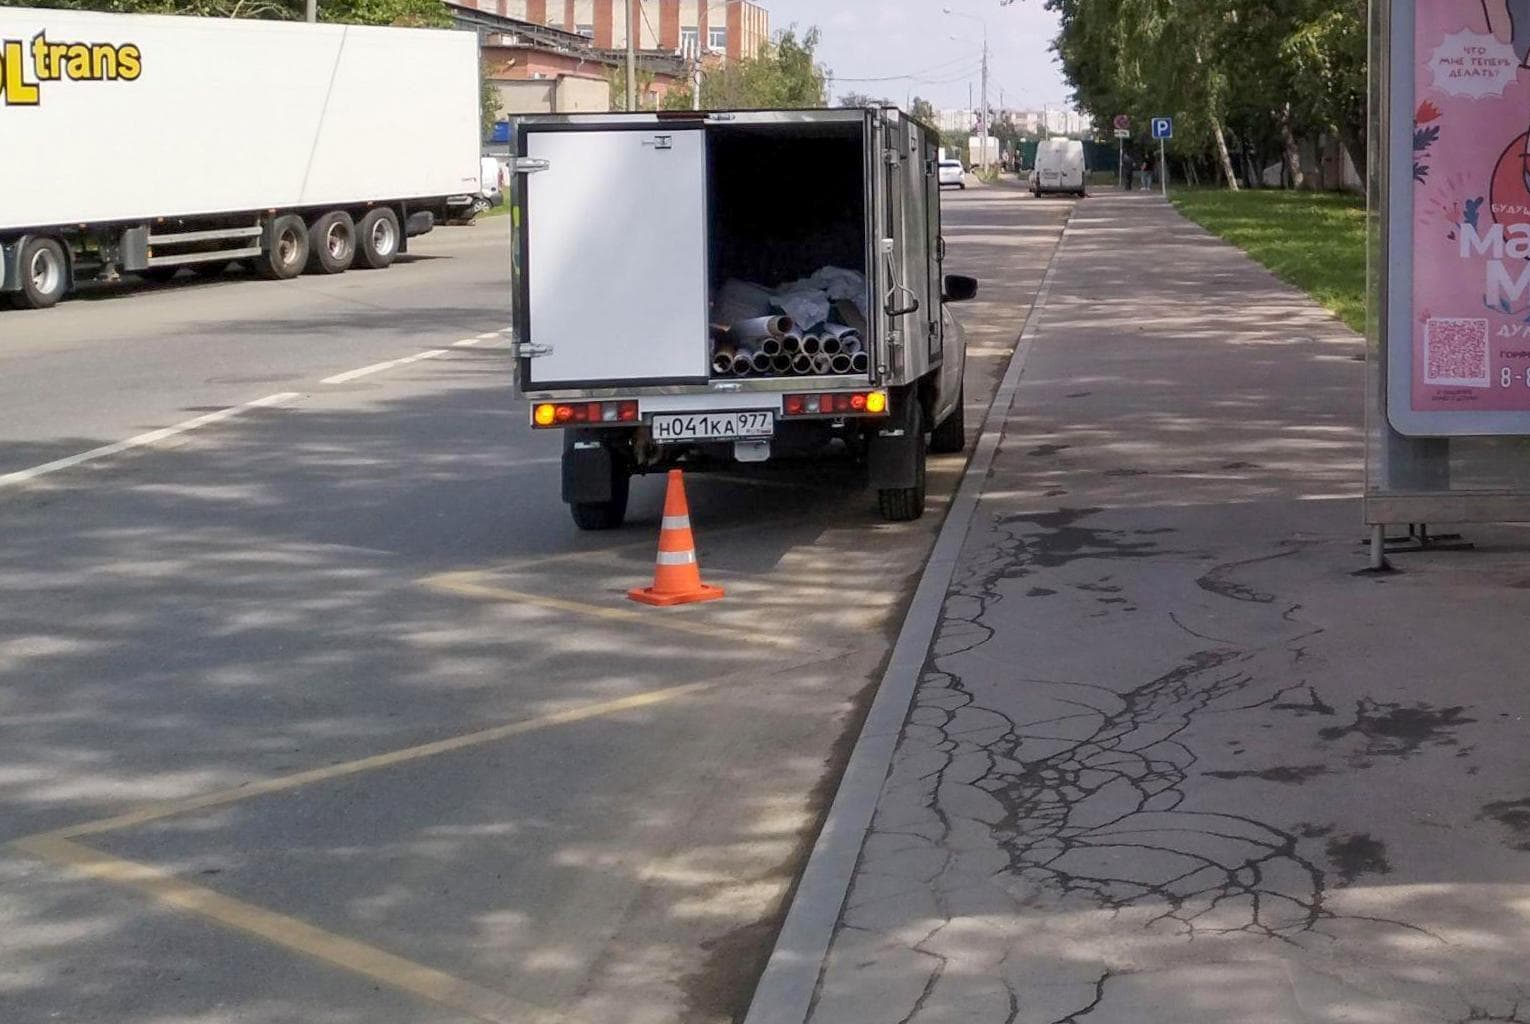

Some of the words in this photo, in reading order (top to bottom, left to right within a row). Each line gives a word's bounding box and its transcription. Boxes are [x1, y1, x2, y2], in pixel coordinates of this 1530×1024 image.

[1464, 45, 1486, 55] ЧТО
[1439, 57, 1465, 66] МНЕ
[1470, 57, 1511, 66] ТЕПЕРЬ
[738, 413, 768, 428] 977
